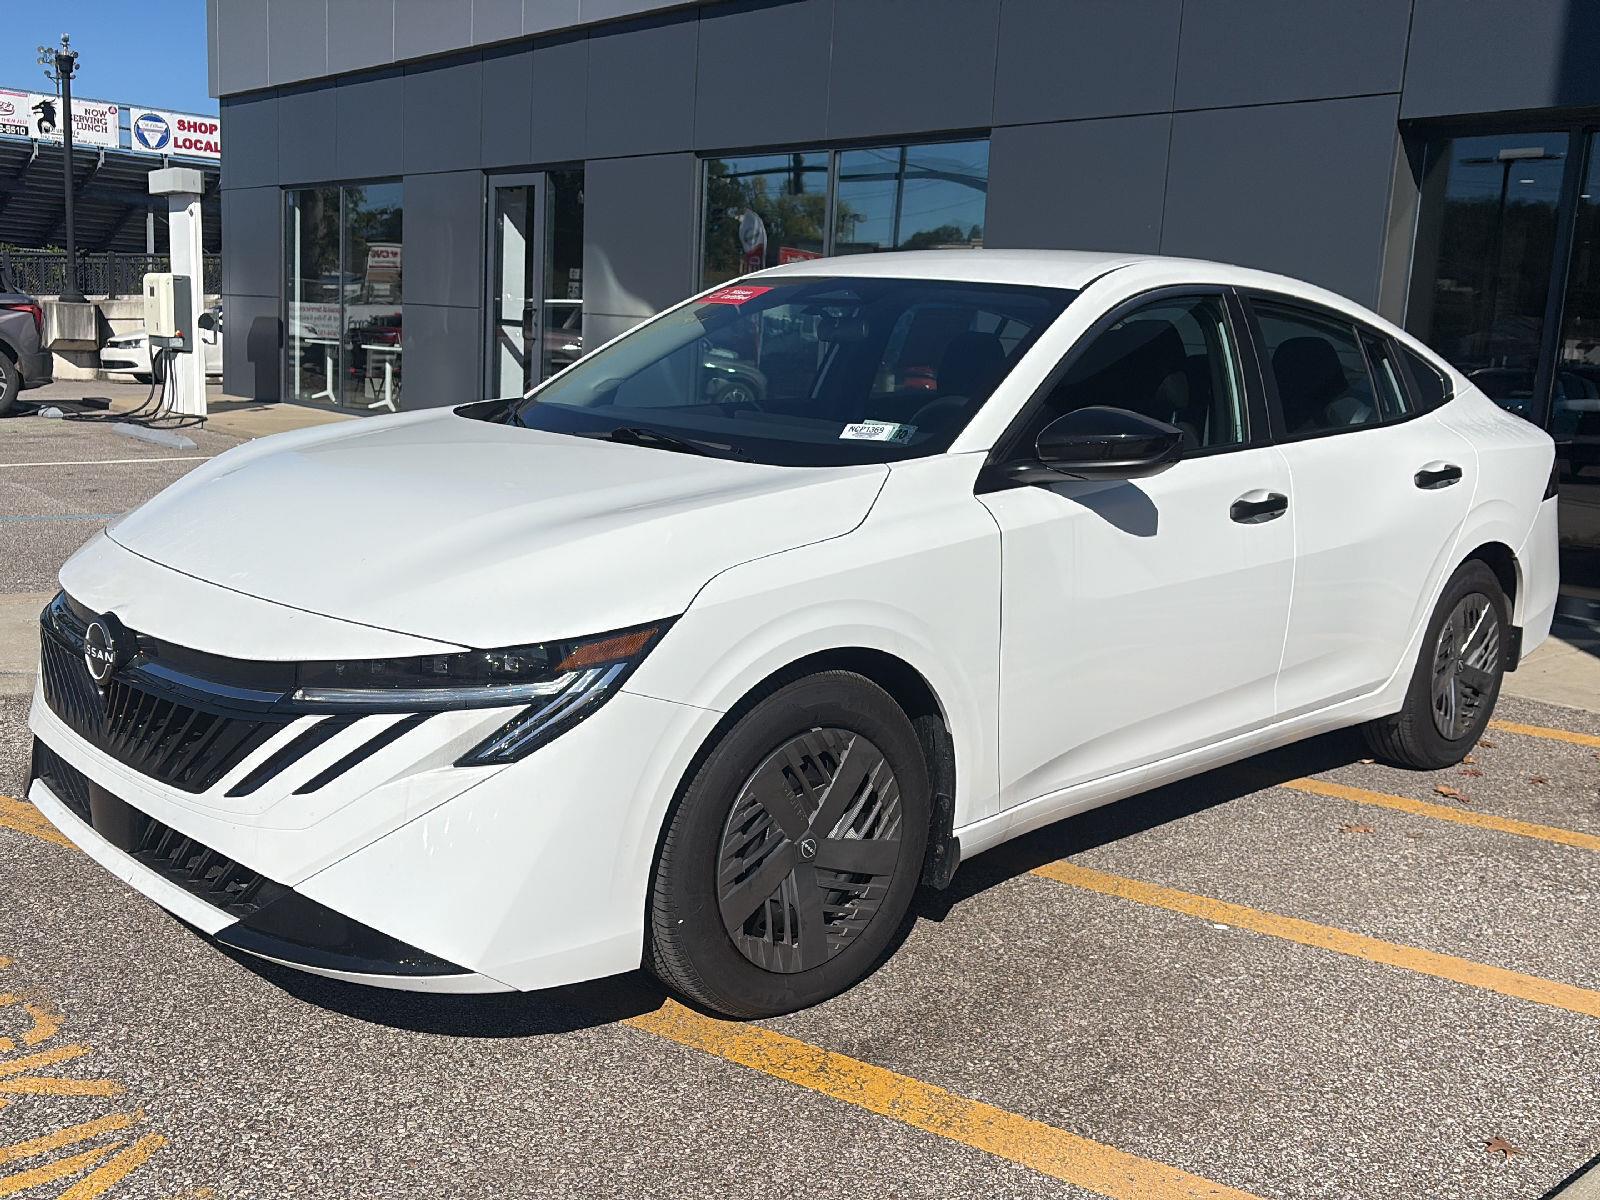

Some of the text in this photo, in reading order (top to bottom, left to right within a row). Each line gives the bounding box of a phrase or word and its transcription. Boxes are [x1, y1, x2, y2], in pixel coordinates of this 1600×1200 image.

[71, 113, 108, 126] ERVING
[84, 108, 108, 118] NOW
[76, 122, 108, 134] LUNCH
[177, 119, 218, 135] SHOP
[173, 136, 222, 153] LOCAL
